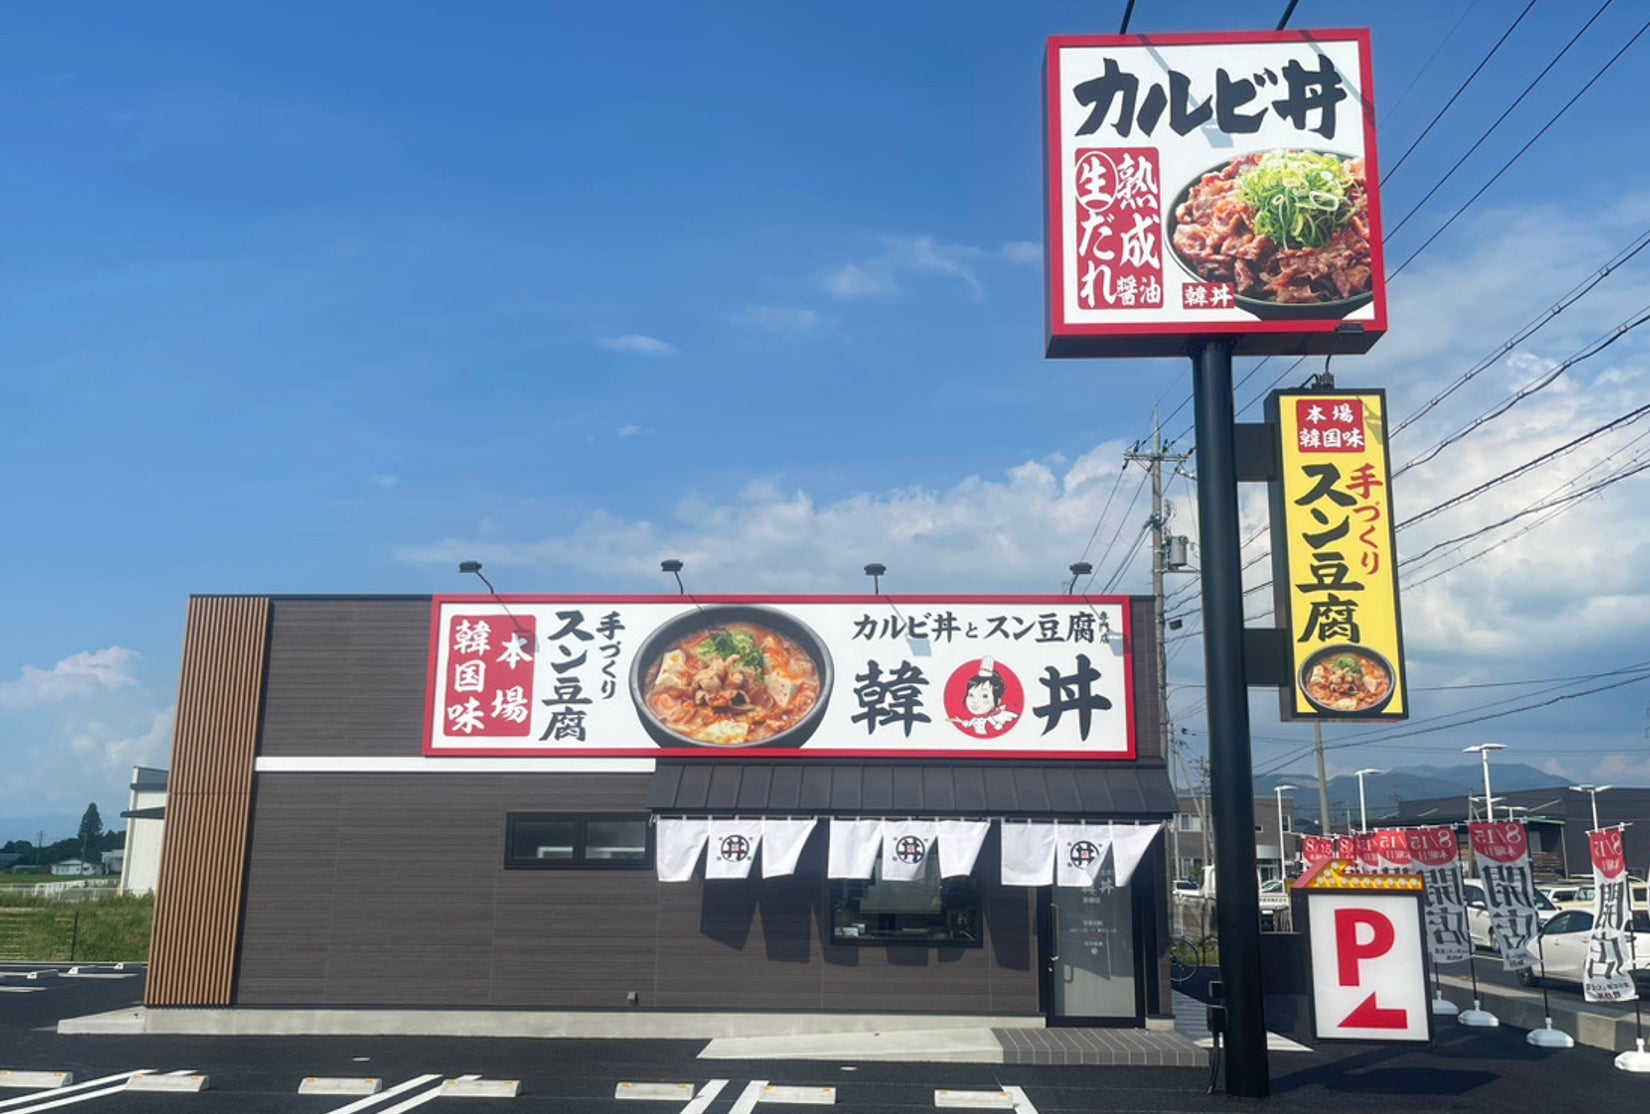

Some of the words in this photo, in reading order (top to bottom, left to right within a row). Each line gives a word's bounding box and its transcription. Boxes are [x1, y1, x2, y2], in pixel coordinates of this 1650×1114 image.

[1073, 54, 1347, 140] カルビ丼
[1077, 153, 1117, 308] 生だれ
[1116, 153, 1161, 269] 熟成
[1116, 278, 1161, 306] 醤油
[1184, 284, 1233, 307] 韓丼
[1299, 427, 1364, 449] 韓国味
[1305, 403, 1354, 424] 本場
[1294, 462, 1365, 643] スン豆腐
[1345, 463, 1383, 575] 手づくり
[596, 611, 626, 700] 手づくり
[852, 611, 1095, 643] カルビ丼とスン豆腐
[447, 619, 492, 734] 韓国味
[491, 632, 534, 724] 本場
[539, 610, 594, 742] スン豆腐
[851, 659, 932, 738] 韓
[1032, 653, 1112, 742] 丼
[1334, 908, 1395, 987] P
